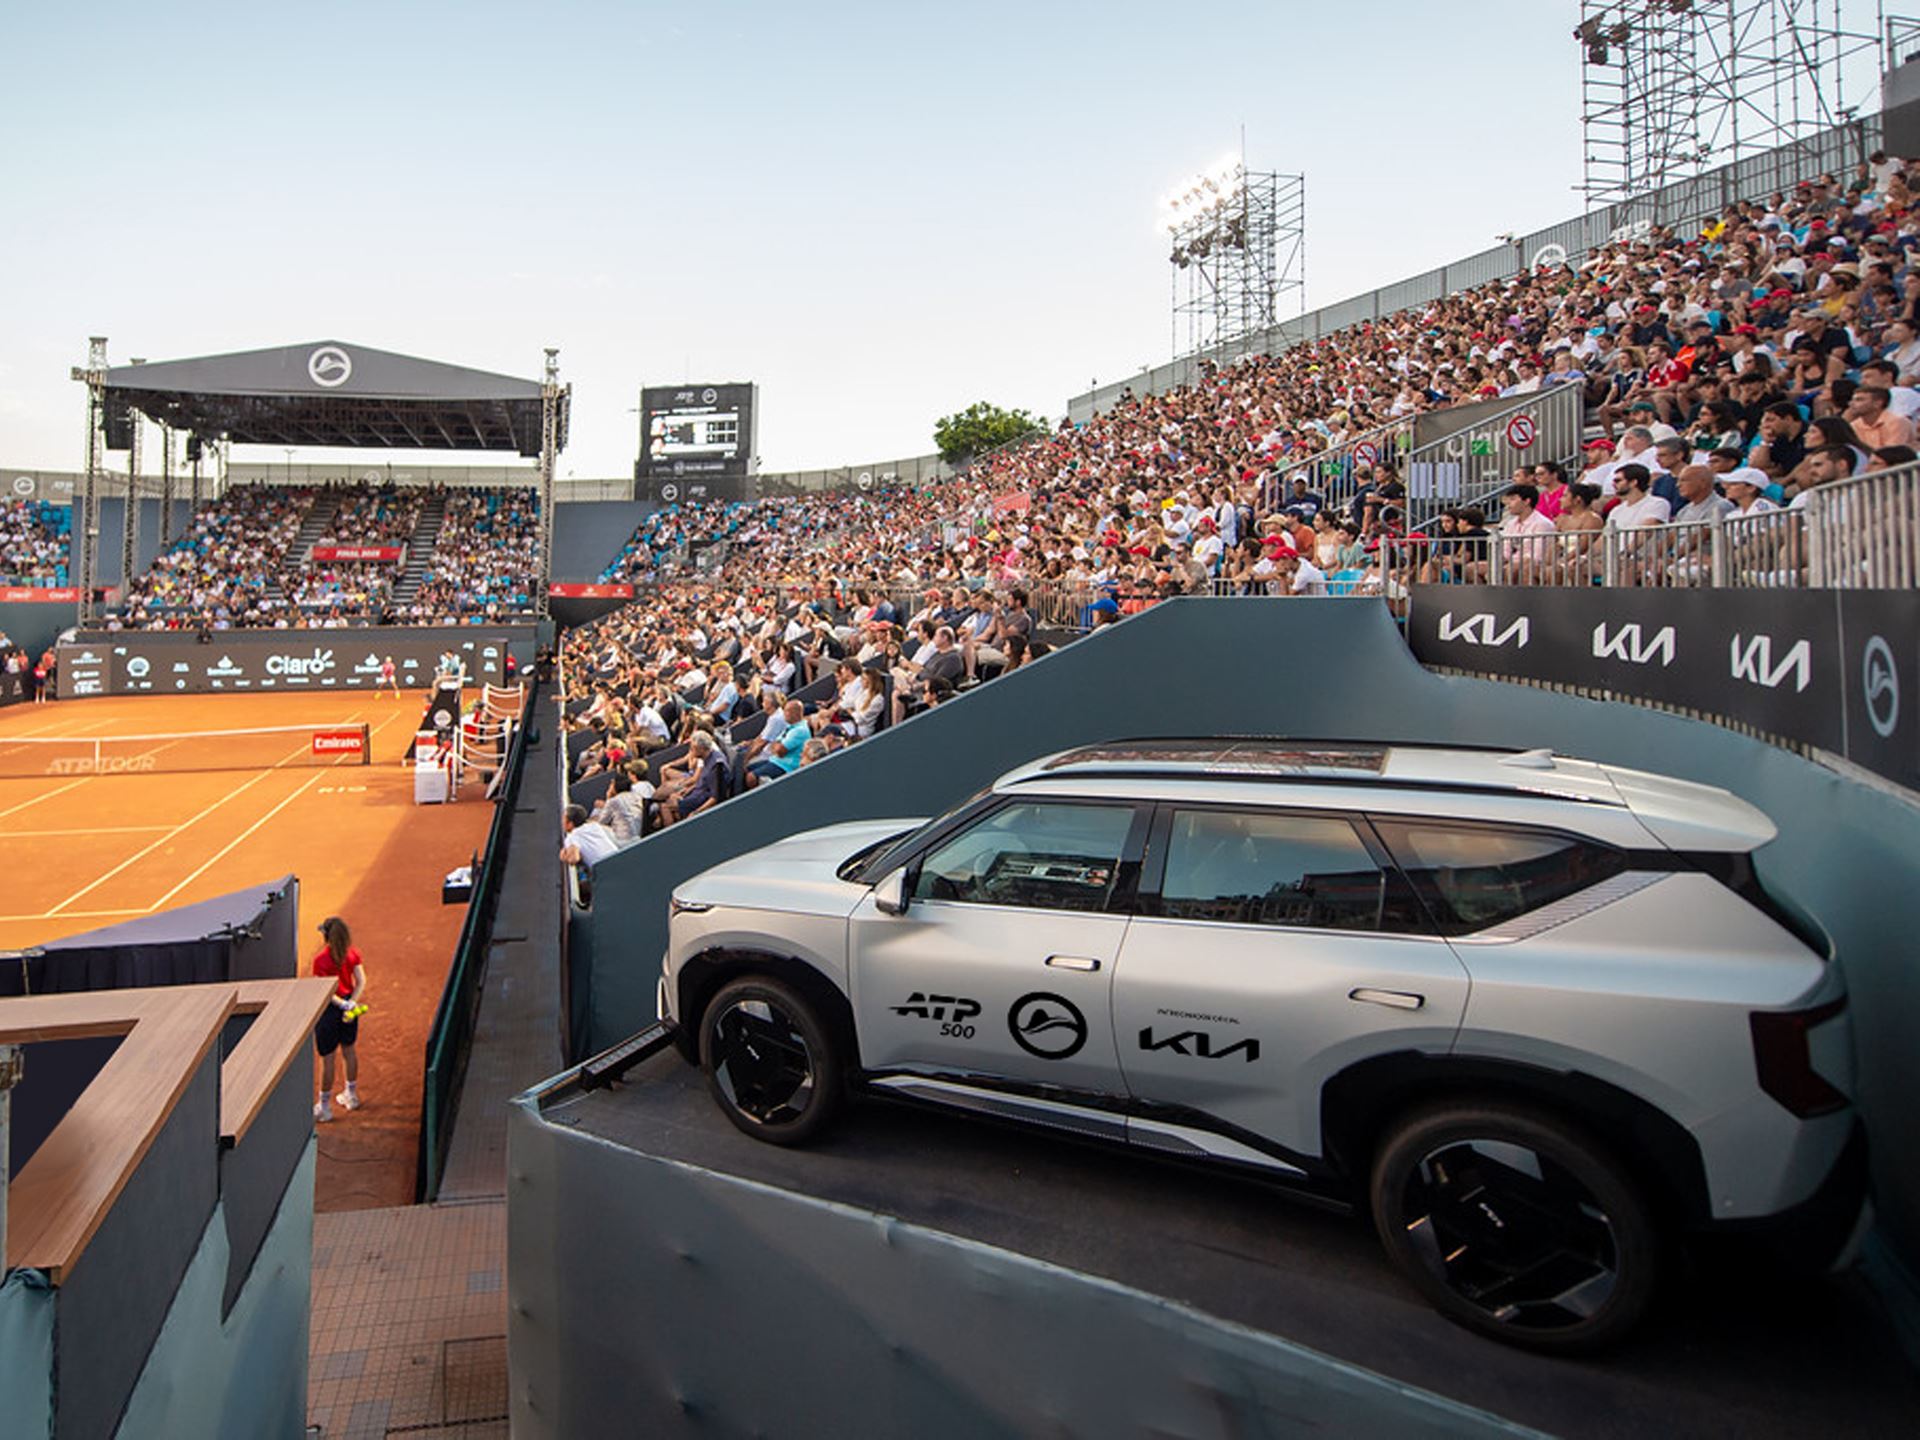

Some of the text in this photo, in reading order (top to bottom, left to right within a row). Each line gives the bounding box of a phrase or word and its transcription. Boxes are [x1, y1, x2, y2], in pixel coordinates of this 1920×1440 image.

[1438, 611, 1531, 649] KIA
[1592, 621, 1677, 667] KIA
[265, 652, 329, 675] Claro
[1731, 632, 1812, 693] KIA
[315, 736, 361, 749] Emirates
[46, 755, 156, 775] ATP TOUR
[888, 991, 982, 1022] ATP
[940, 1022, 976, 1039] 500
[1139, 1026, 1261, 1063] KIA
